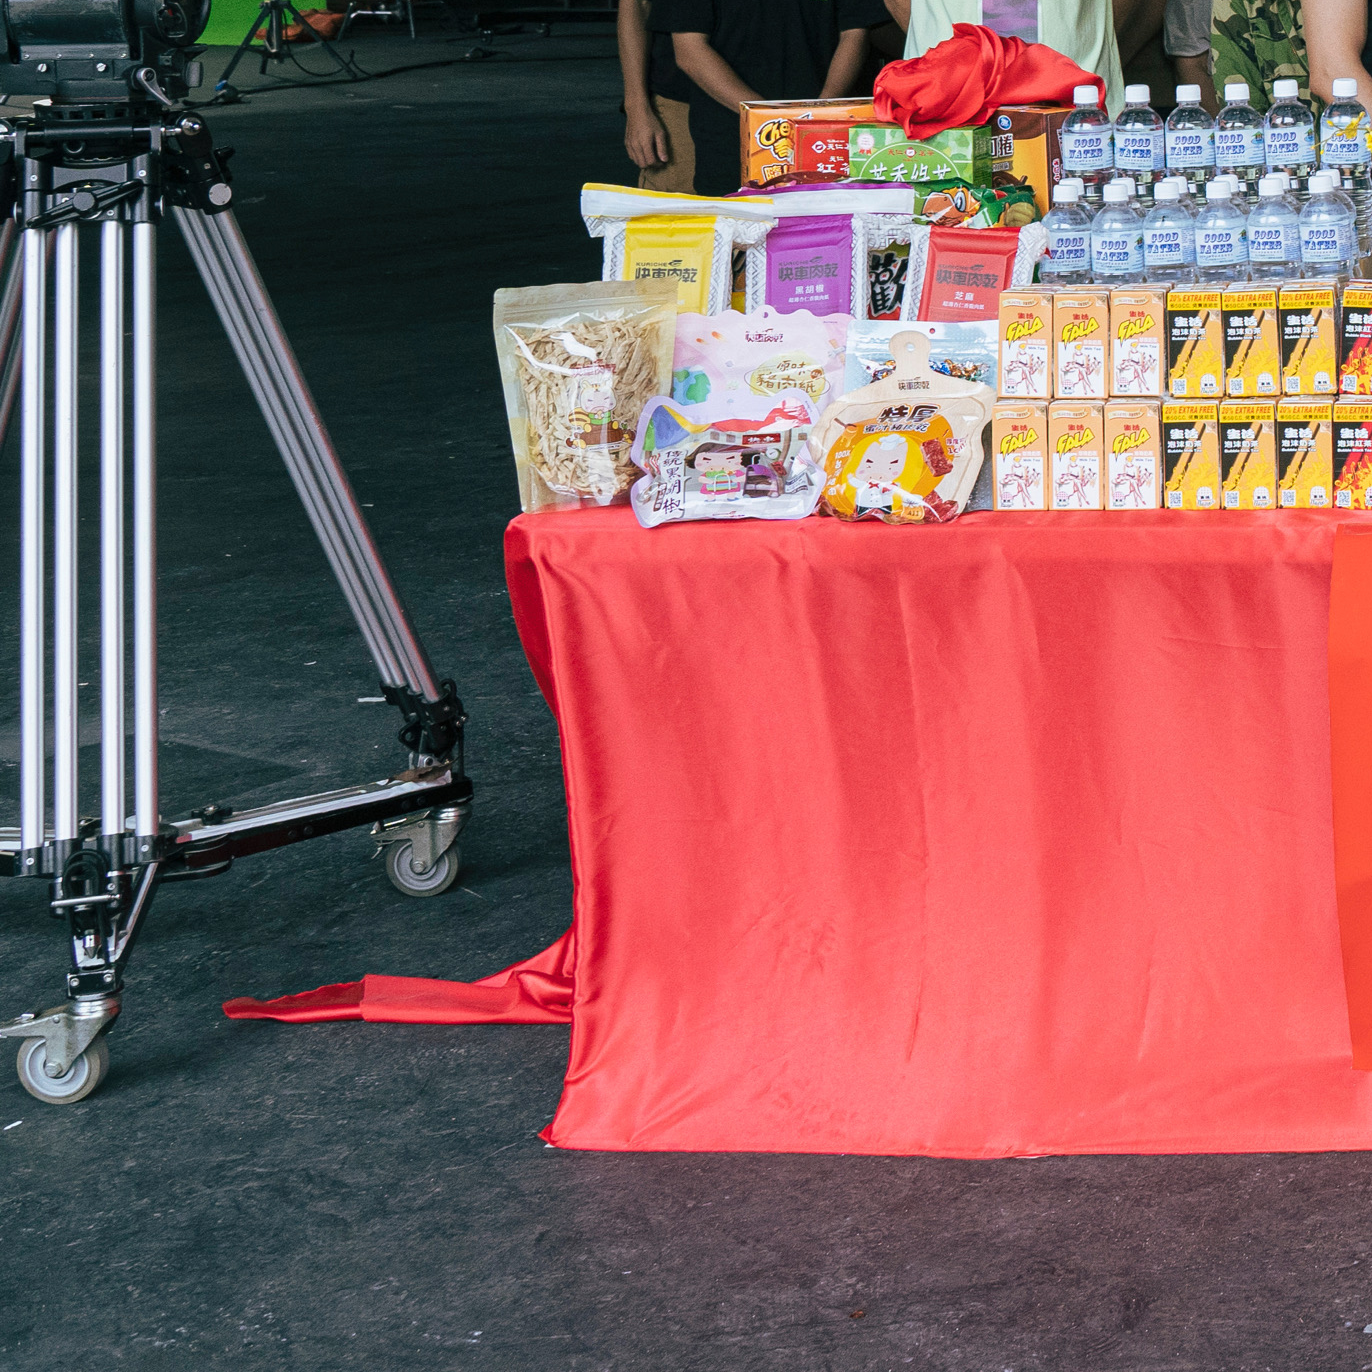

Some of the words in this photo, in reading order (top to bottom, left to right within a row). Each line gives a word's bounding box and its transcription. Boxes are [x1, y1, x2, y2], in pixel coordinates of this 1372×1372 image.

[1073, 138, 1101, 148] GOOD
[1174, 135, 1201, 145] GOOD
[1270, 132, 1296, 143] GOOD
[1069, 149, 1103, 159] WATER
[1170, 146, 1203, 156] WATER
[1267, 143, 1299, 154] WATER
[1152, 232, 1179, 243] GOOD
[1204, 232, 1231, 243] GOOD
[1308, 229, 1335, 240] GOOD
[1056, 237, 1085, 248] GOOD
[1304, 240, 1337, 250] WATER
[1147, 243, 1181, 254] WATER
[1200, 243, 1233, 254] WATER
[1050, 249, 1086, 260] WATER
[778, 264, 839, 282] 快車肉乾
[935, 271, 999, 289] 快車肉乾
[795, 284, 824, 295] 黑胡椒
[954, 291, 974, 301] 芝麻
[1170, 293, 1181, 302] 20%
[1182, 293, 1202, 302] EXTRA
[1203, 293, 1218, 302] FREE
[1345, 292, 1358, 302] 20%
[1006, 317, 1044, 343] FALA
[1117, 314, 1156, 341] FALA
[878, 403, 940, 424] 特厚
[1000, 428, 1039, 455] FALA
[1112, 428, 1151, 455] FALA
